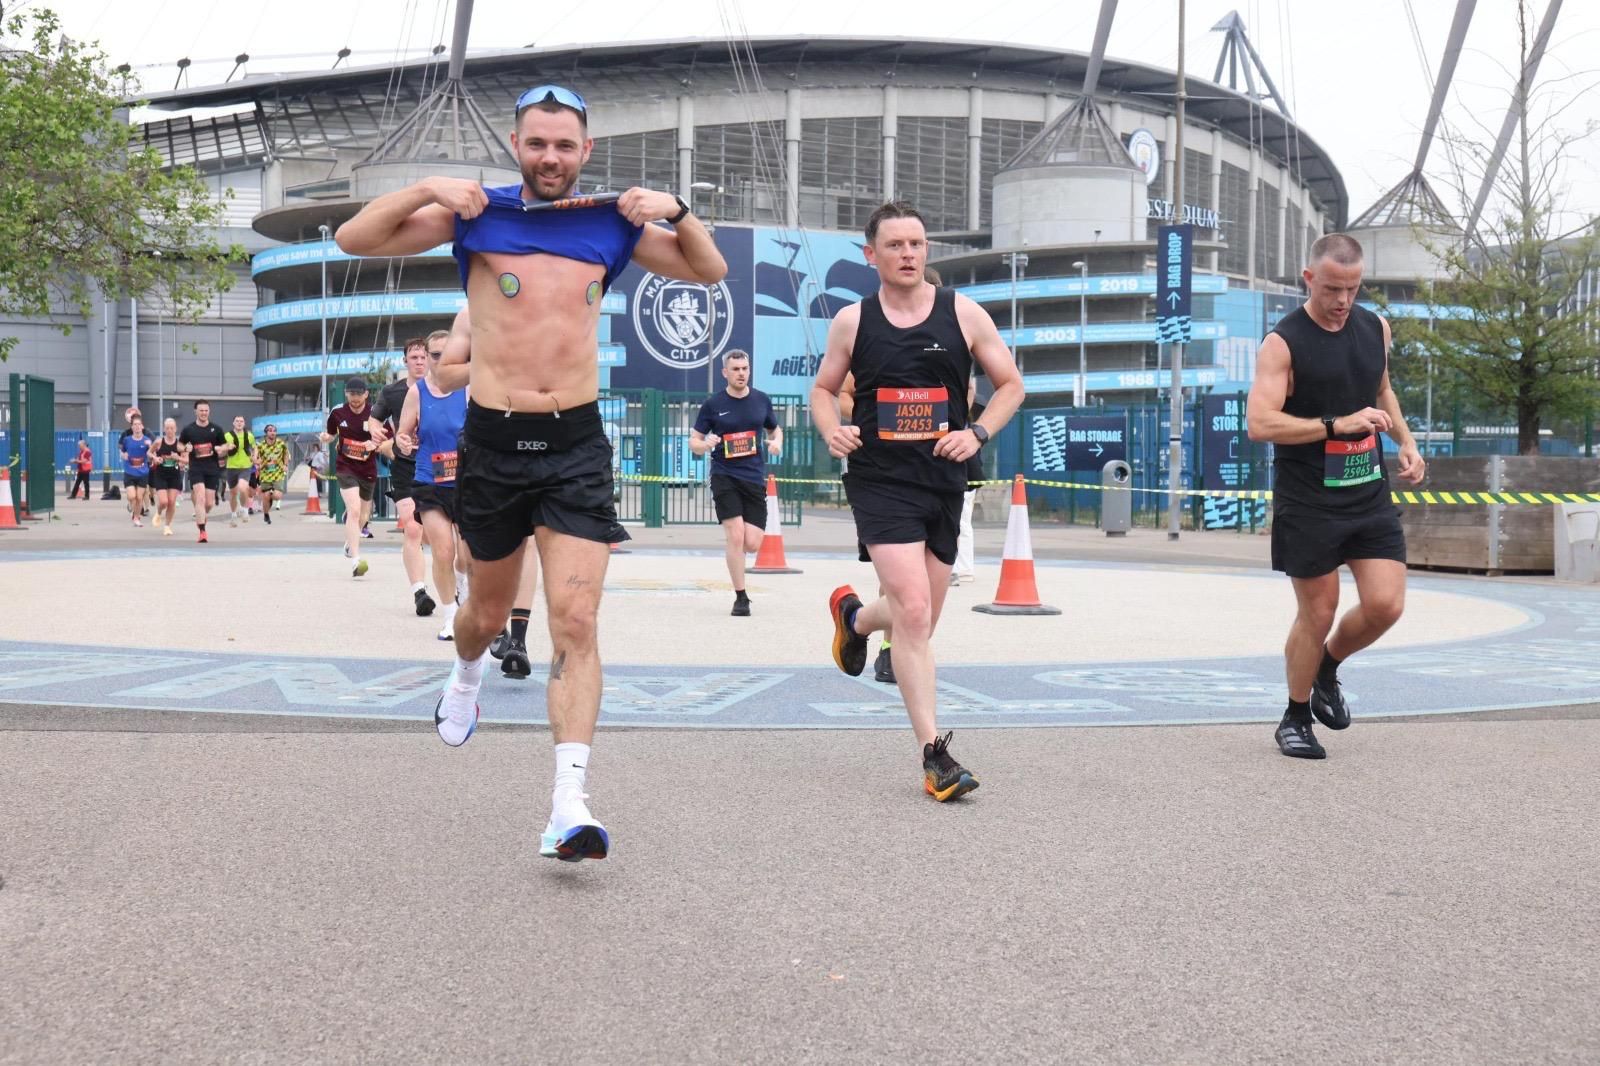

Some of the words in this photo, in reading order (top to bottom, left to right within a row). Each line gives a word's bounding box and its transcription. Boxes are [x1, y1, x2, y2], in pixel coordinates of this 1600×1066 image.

[1167, 232, 1182, 263] DROP
[1167, 264, 1181, 288] BAG
[1099, 278, 1137, 292] 2019
[1034, 329, 1076, 342] 2003
[670, 349, 700, 360] CITY
[292, 361, 315, 372] CITY
[1118, 374, 1154, 386] 1968
[896, 404, 933, 417] JASON
[1224, 400, 1246, 415] BA
[897, 418, 933, 431] 22453
[1070, 430, 1086, 442] BAG
[1087, 430, 1122, 442] STORAGE
[517, 440, 548, 450] EXEO
[1344, 452, 1370, 466] LESLIE
[1344, 464, 1370, 478] 25965
